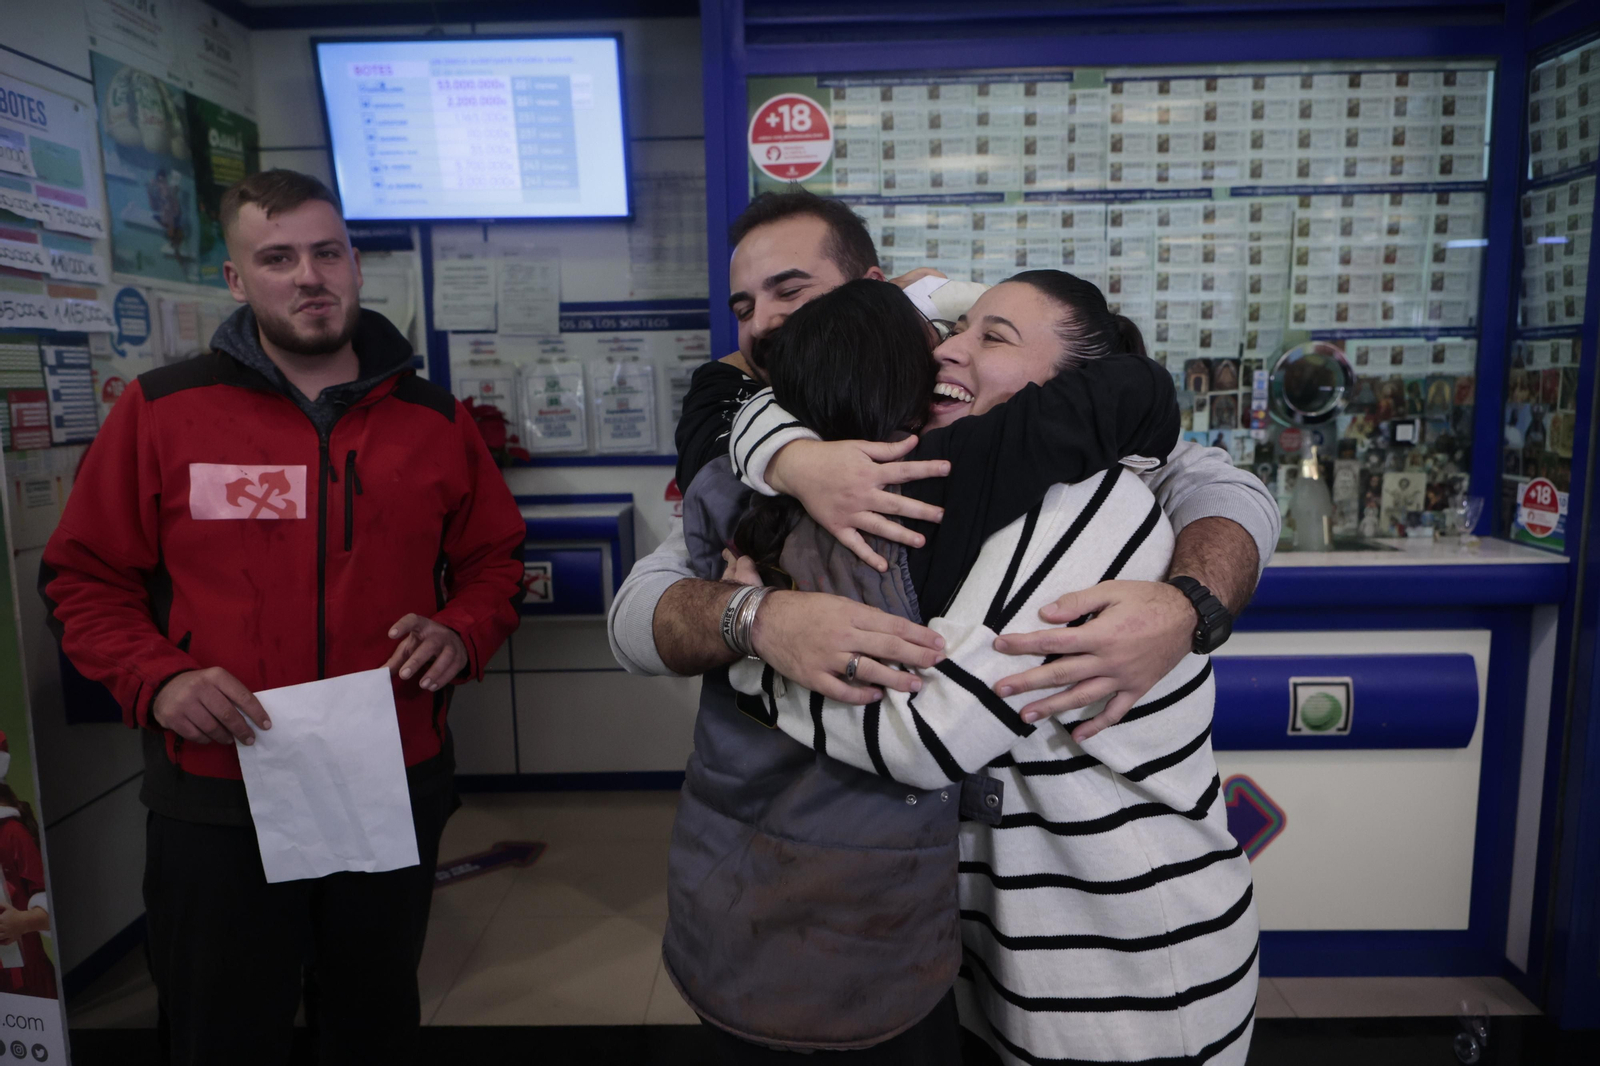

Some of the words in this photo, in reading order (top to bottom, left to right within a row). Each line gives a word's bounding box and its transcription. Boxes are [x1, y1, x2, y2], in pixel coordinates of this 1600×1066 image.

[354, 64, 394, 77] BOTES
[765, 103, 812, 133] +18
[596, 319, 616, 328] LOS
[619, 318, 669, 328] SORTEOS
[1529, 484, 1552, 505] +18
[723, 607, 735, 636] ARIES
